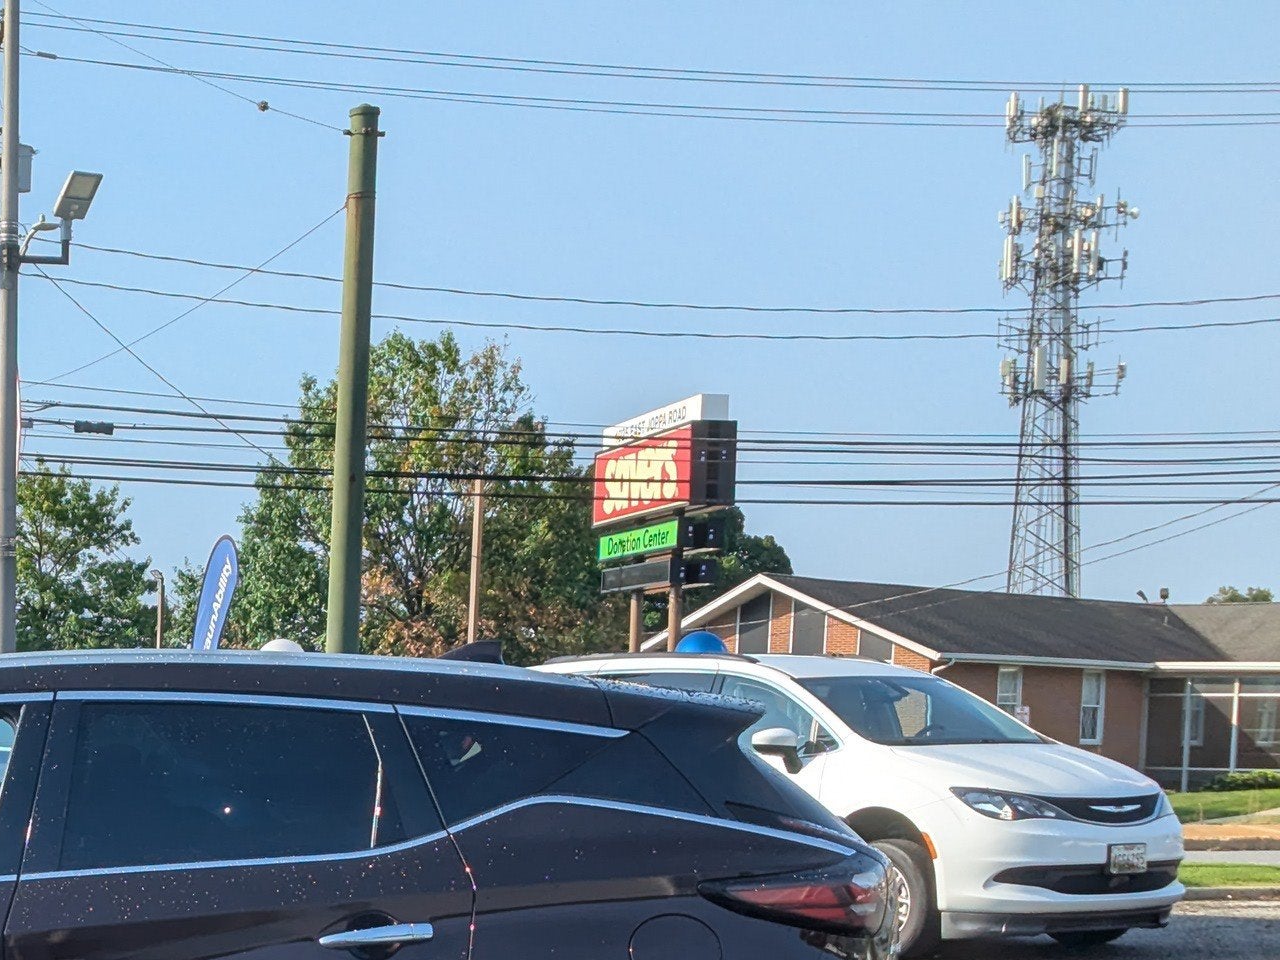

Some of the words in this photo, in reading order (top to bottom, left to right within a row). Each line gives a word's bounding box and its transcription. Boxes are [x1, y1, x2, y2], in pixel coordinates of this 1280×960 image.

[668, 405, 687, 424] ROAD
[643, 529, 670, 549] Center
[204, 554, 232, 650] aunAbility
